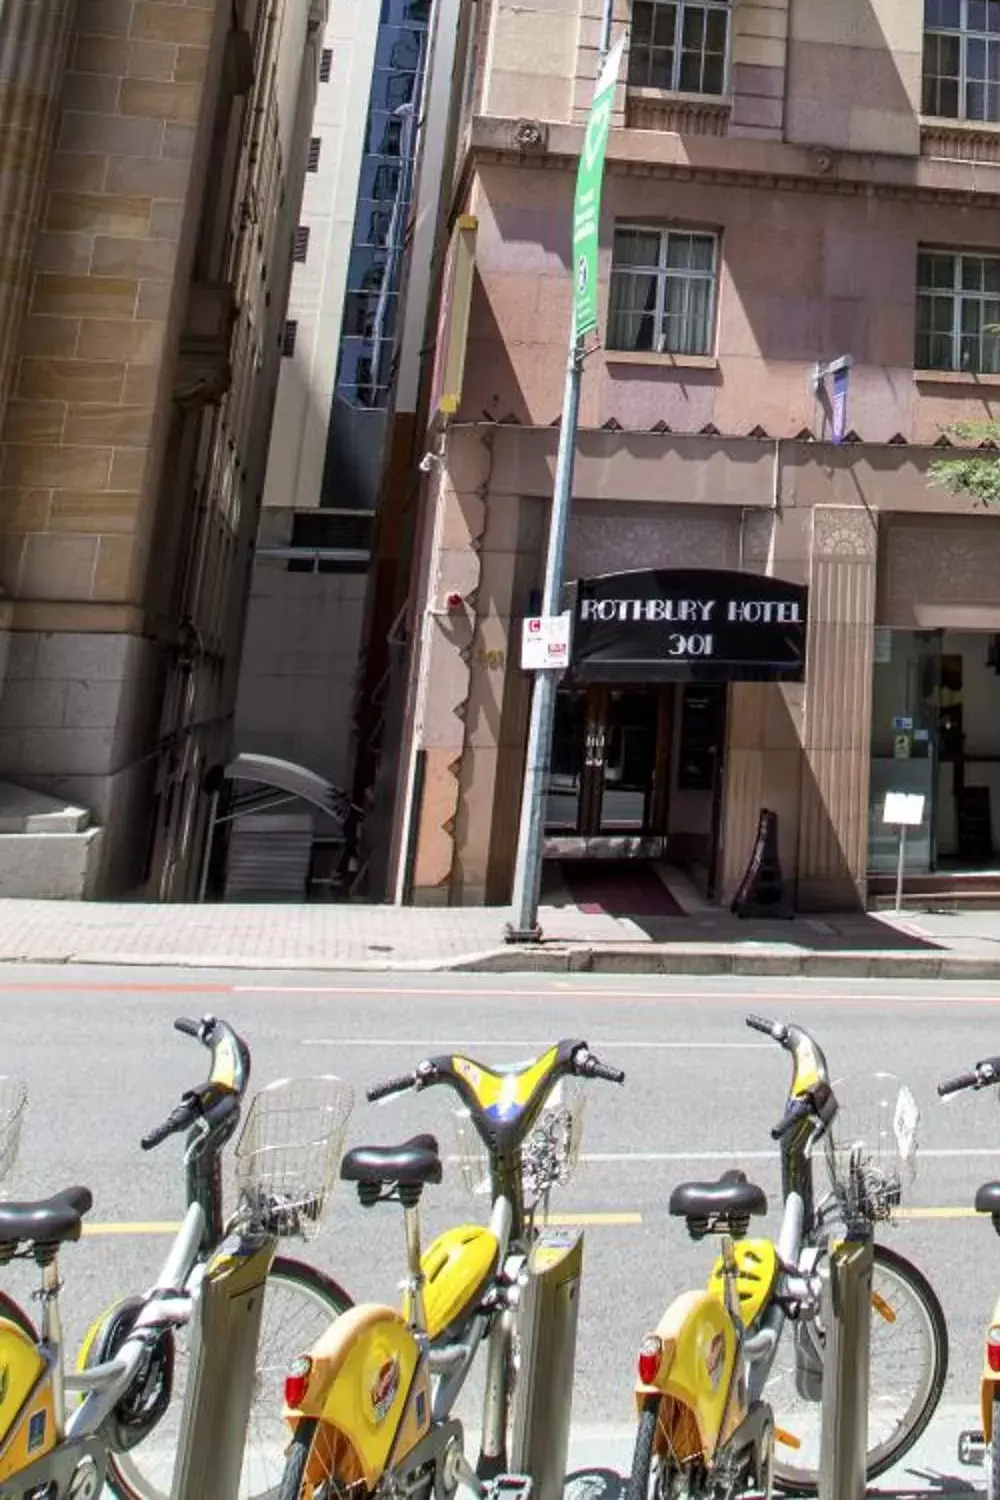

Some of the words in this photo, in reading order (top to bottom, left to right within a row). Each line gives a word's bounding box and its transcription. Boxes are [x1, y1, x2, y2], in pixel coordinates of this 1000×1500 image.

[581, 599, 715, 621] ROTHBURY
[727, 601, 804, 623] HOTEL
[669, 633, 714, 655] 301
